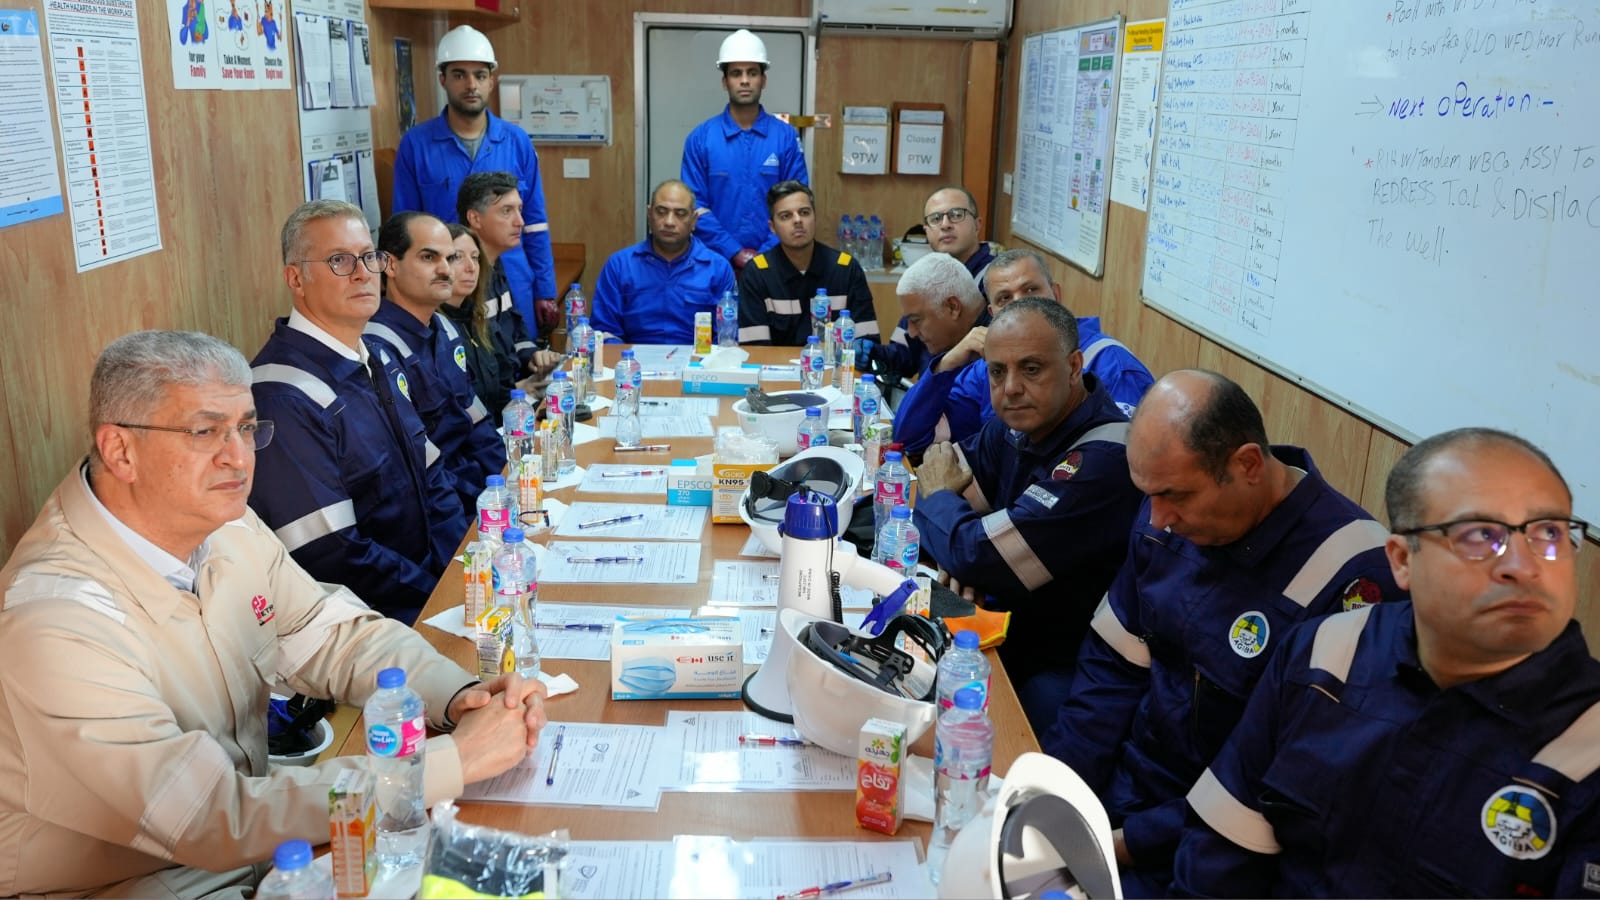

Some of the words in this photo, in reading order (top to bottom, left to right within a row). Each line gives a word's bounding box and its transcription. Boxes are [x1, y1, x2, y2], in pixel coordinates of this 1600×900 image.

[51, 1, 70, 10] HEALTH
[71, 3, 91, 12] HAZARDS
[107, 8, 133, 17] WORKPLACE
[196, 53, 205, 63] your
[223, 54, 234, 65] Take
[264, 56, 276, 66] Choose
[190, 65, 207, 79] Family
[222, 66, 233, 79] Save
[233, 67, 244, 79] Your
[244, 68, 255, 79] Hands
[265, 68, 276, 80] Right
[853, 136, 878, 146] Open
[907, 135, 937, 145] Closed
[852, 152, 879, 164] PTW
[908, 154, 933, 165] PTW
[1373, 177, 1436, 208] REDRESS
[1368, 217, 1392, 249] The
[677, 479, 712, 490] EPSCO
[1230, 639, 1256, 655] AGIBA
[708, 655, 724, 663] use
[862, 773, 893, 791] تفاح
[1491, 830, 1535, 853] AGIBA
